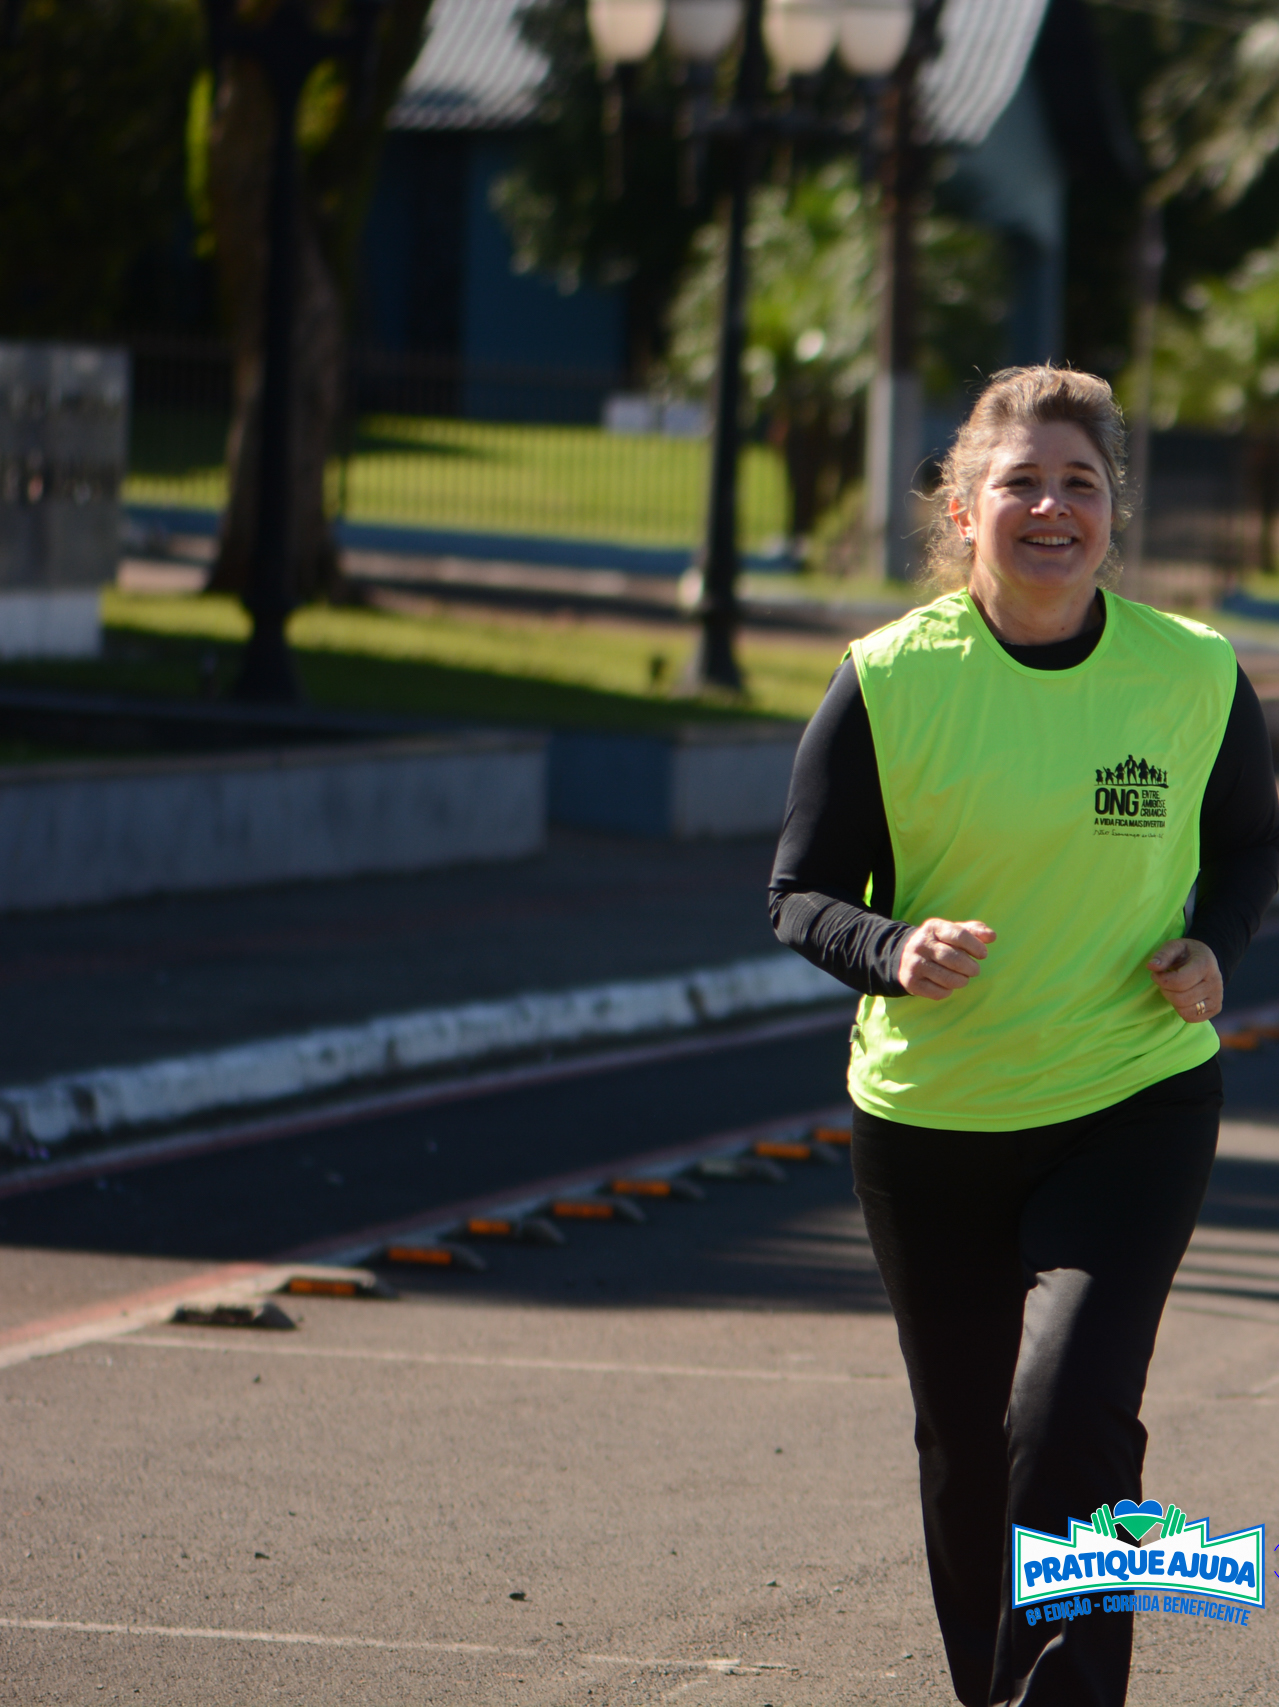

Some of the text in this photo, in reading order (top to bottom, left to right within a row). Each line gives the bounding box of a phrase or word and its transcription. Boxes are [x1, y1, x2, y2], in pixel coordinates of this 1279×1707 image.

[1142, 790, 1160, 799] ENTRE
[1095, 787, 1139, 816] ONG
[1100, 818, 1115, 826] VIDA
[1115, 819, 1128, 827] FICA
